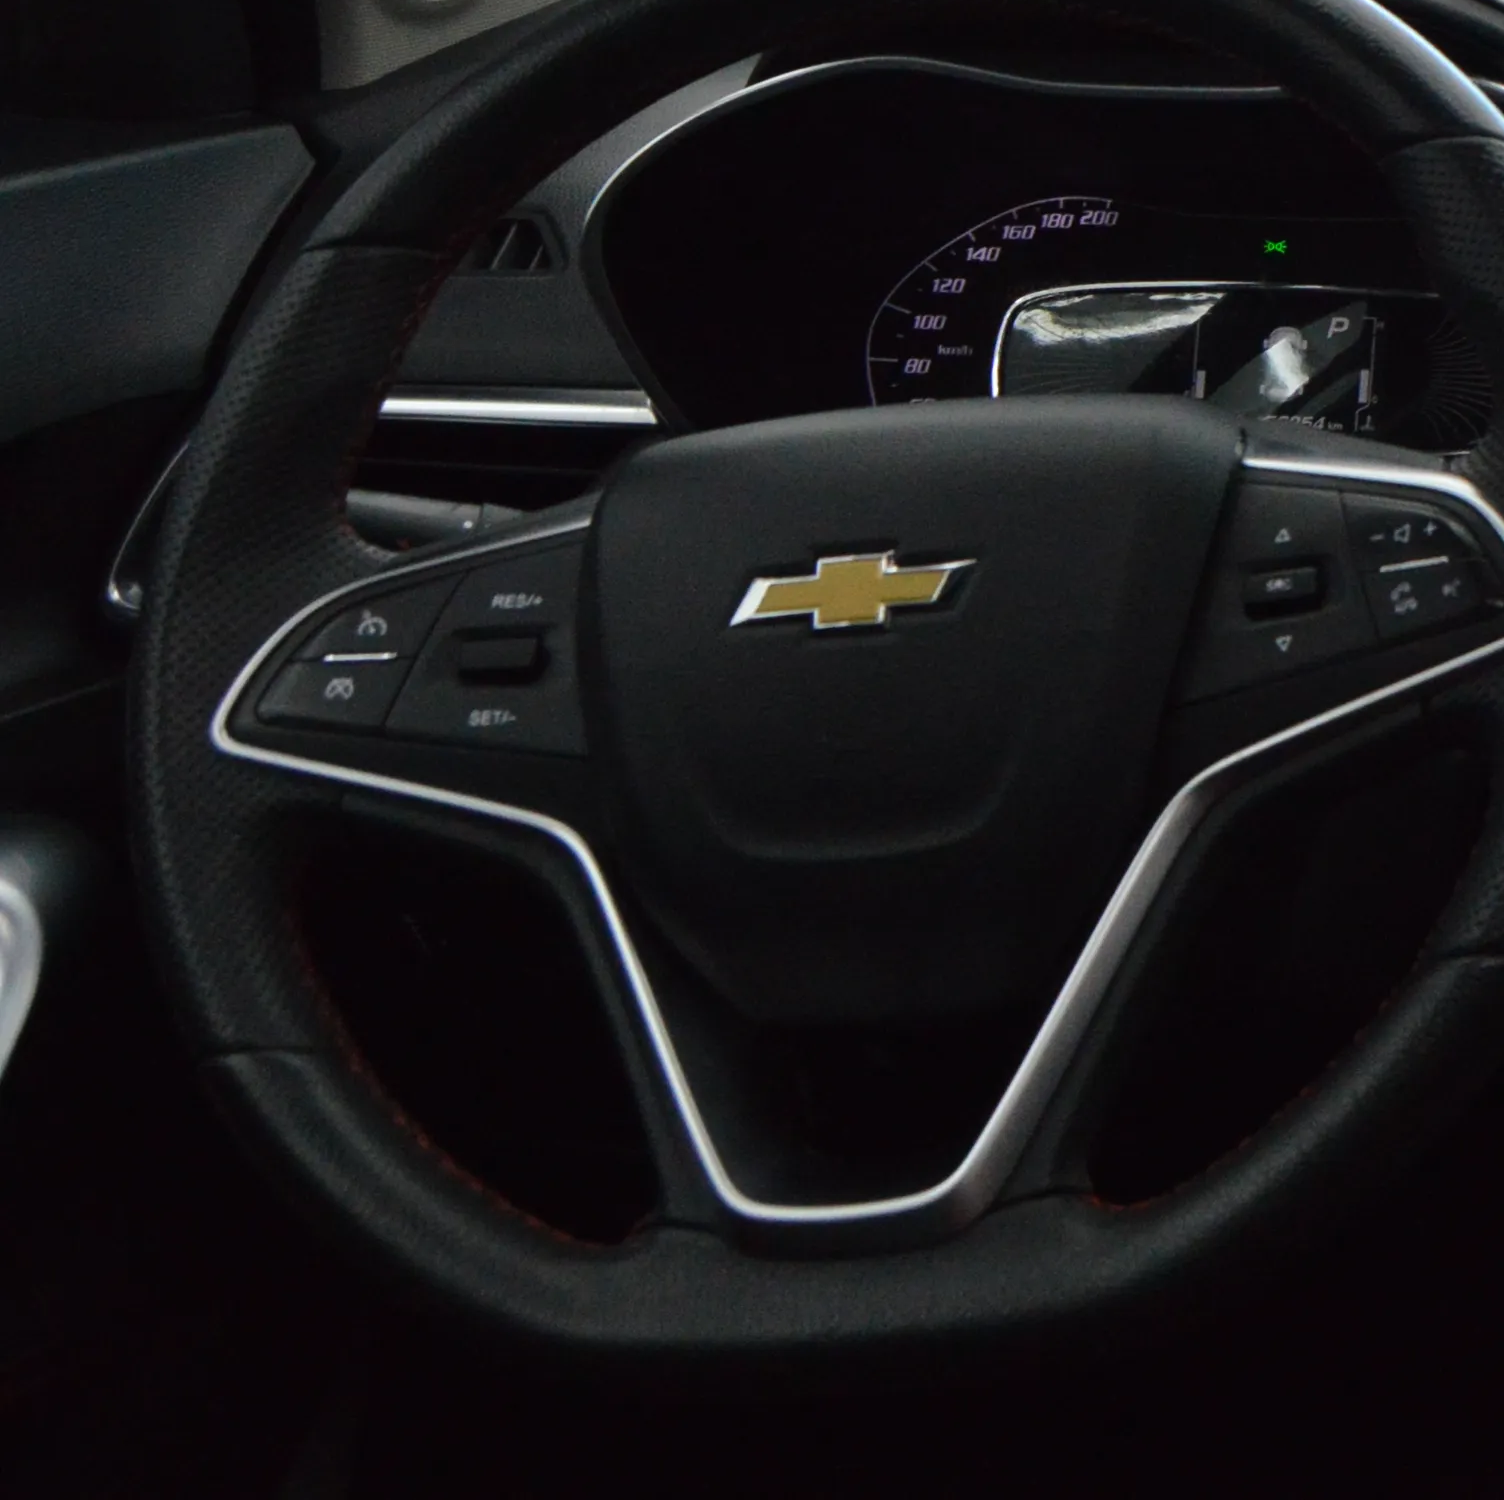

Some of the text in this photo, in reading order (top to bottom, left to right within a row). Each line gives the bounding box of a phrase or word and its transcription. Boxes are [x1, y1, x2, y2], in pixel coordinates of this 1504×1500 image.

[1041, 213, 1074, 230] 180
[1080, 210, 1119, 227] 200
[1002, 225, 1036, 240] 160
[966, 247, 1001, 262] 140
[932, 278, 966, 294] 120
[913, 315, 947, 330] 100
[1326, 317, 1350, 340] P
[904, 358, 932, 374] 80
